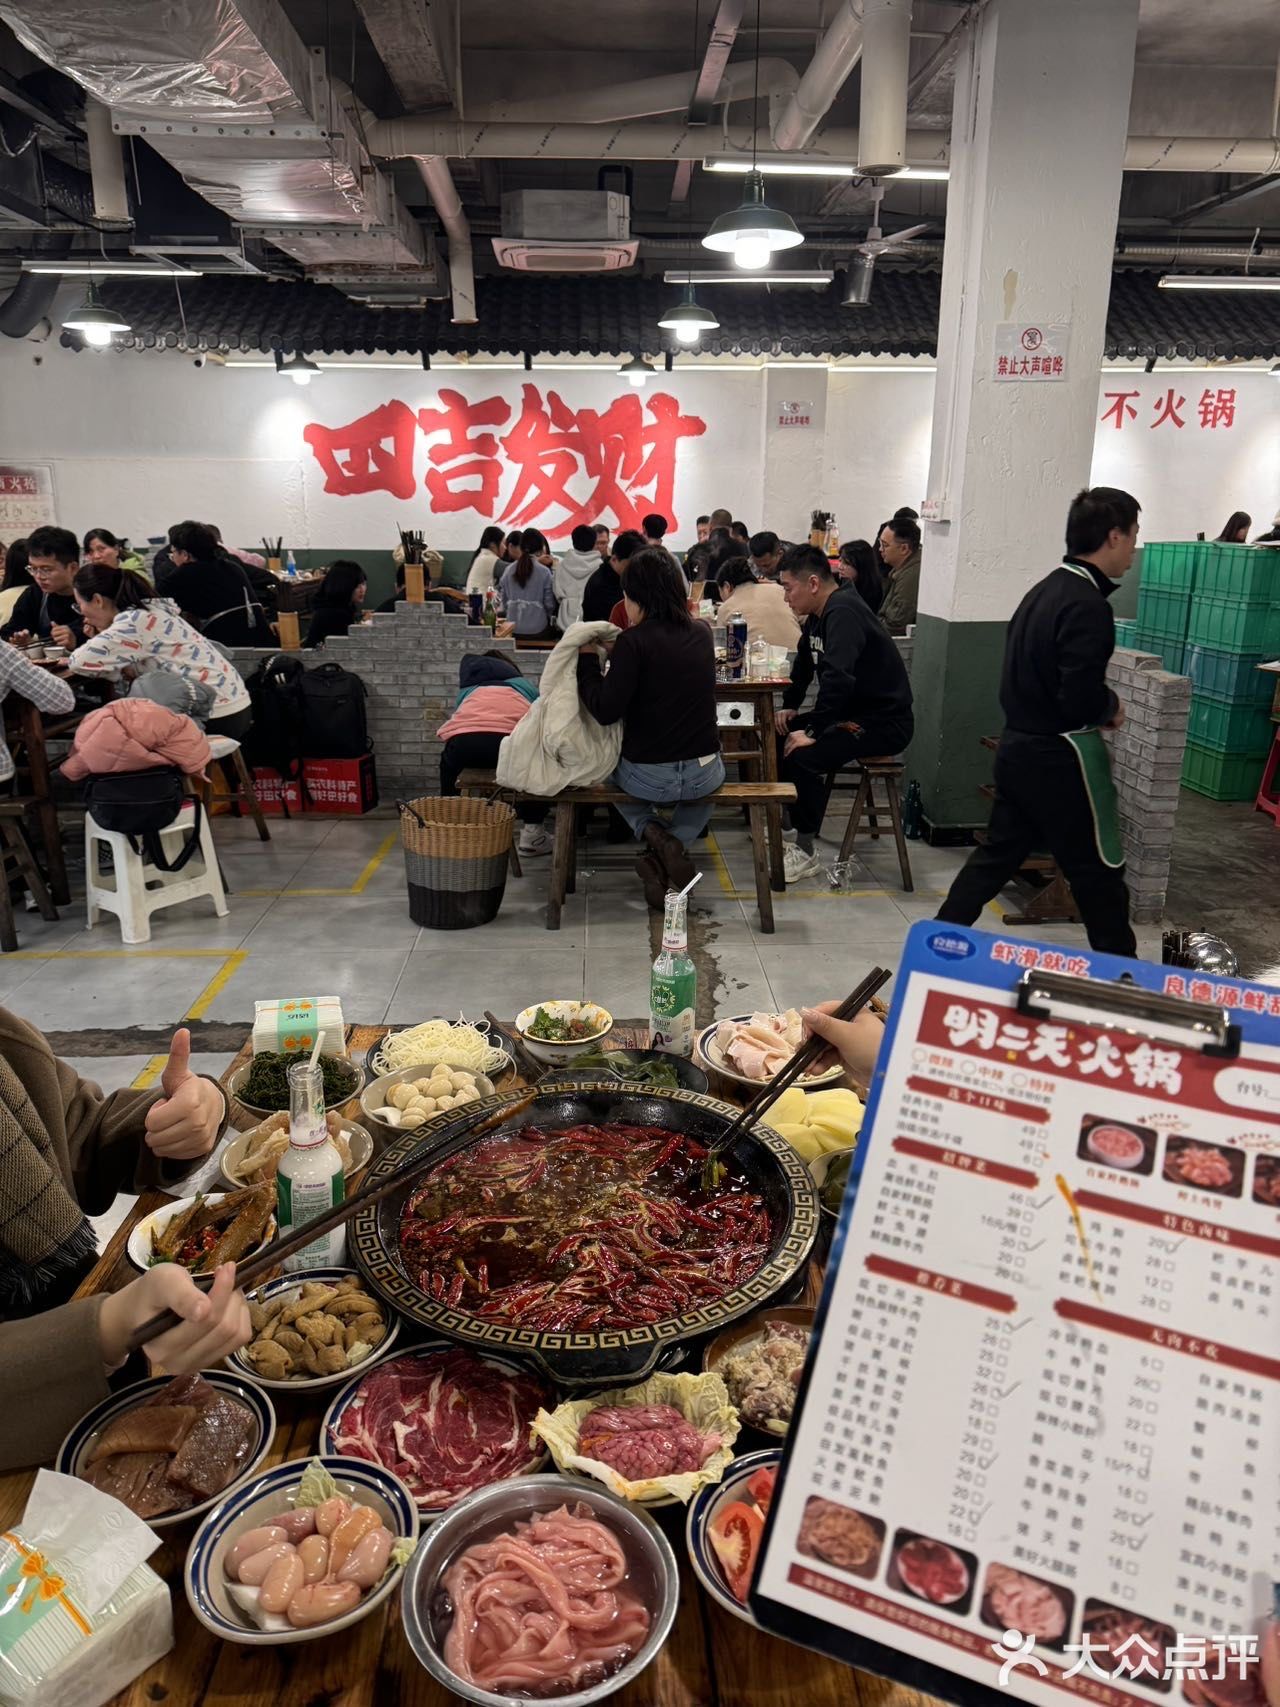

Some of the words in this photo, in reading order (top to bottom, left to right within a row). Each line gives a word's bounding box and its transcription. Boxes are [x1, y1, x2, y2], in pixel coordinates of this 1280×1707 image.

[998, 356, 1063, 375] 禁止大声喧哗
[1101, 388, 1236, 429] 不火锅
[990, 940, 1091, 977] 虾滑就吃
[943, 1004, 1183, 1095] 明二天火锅
